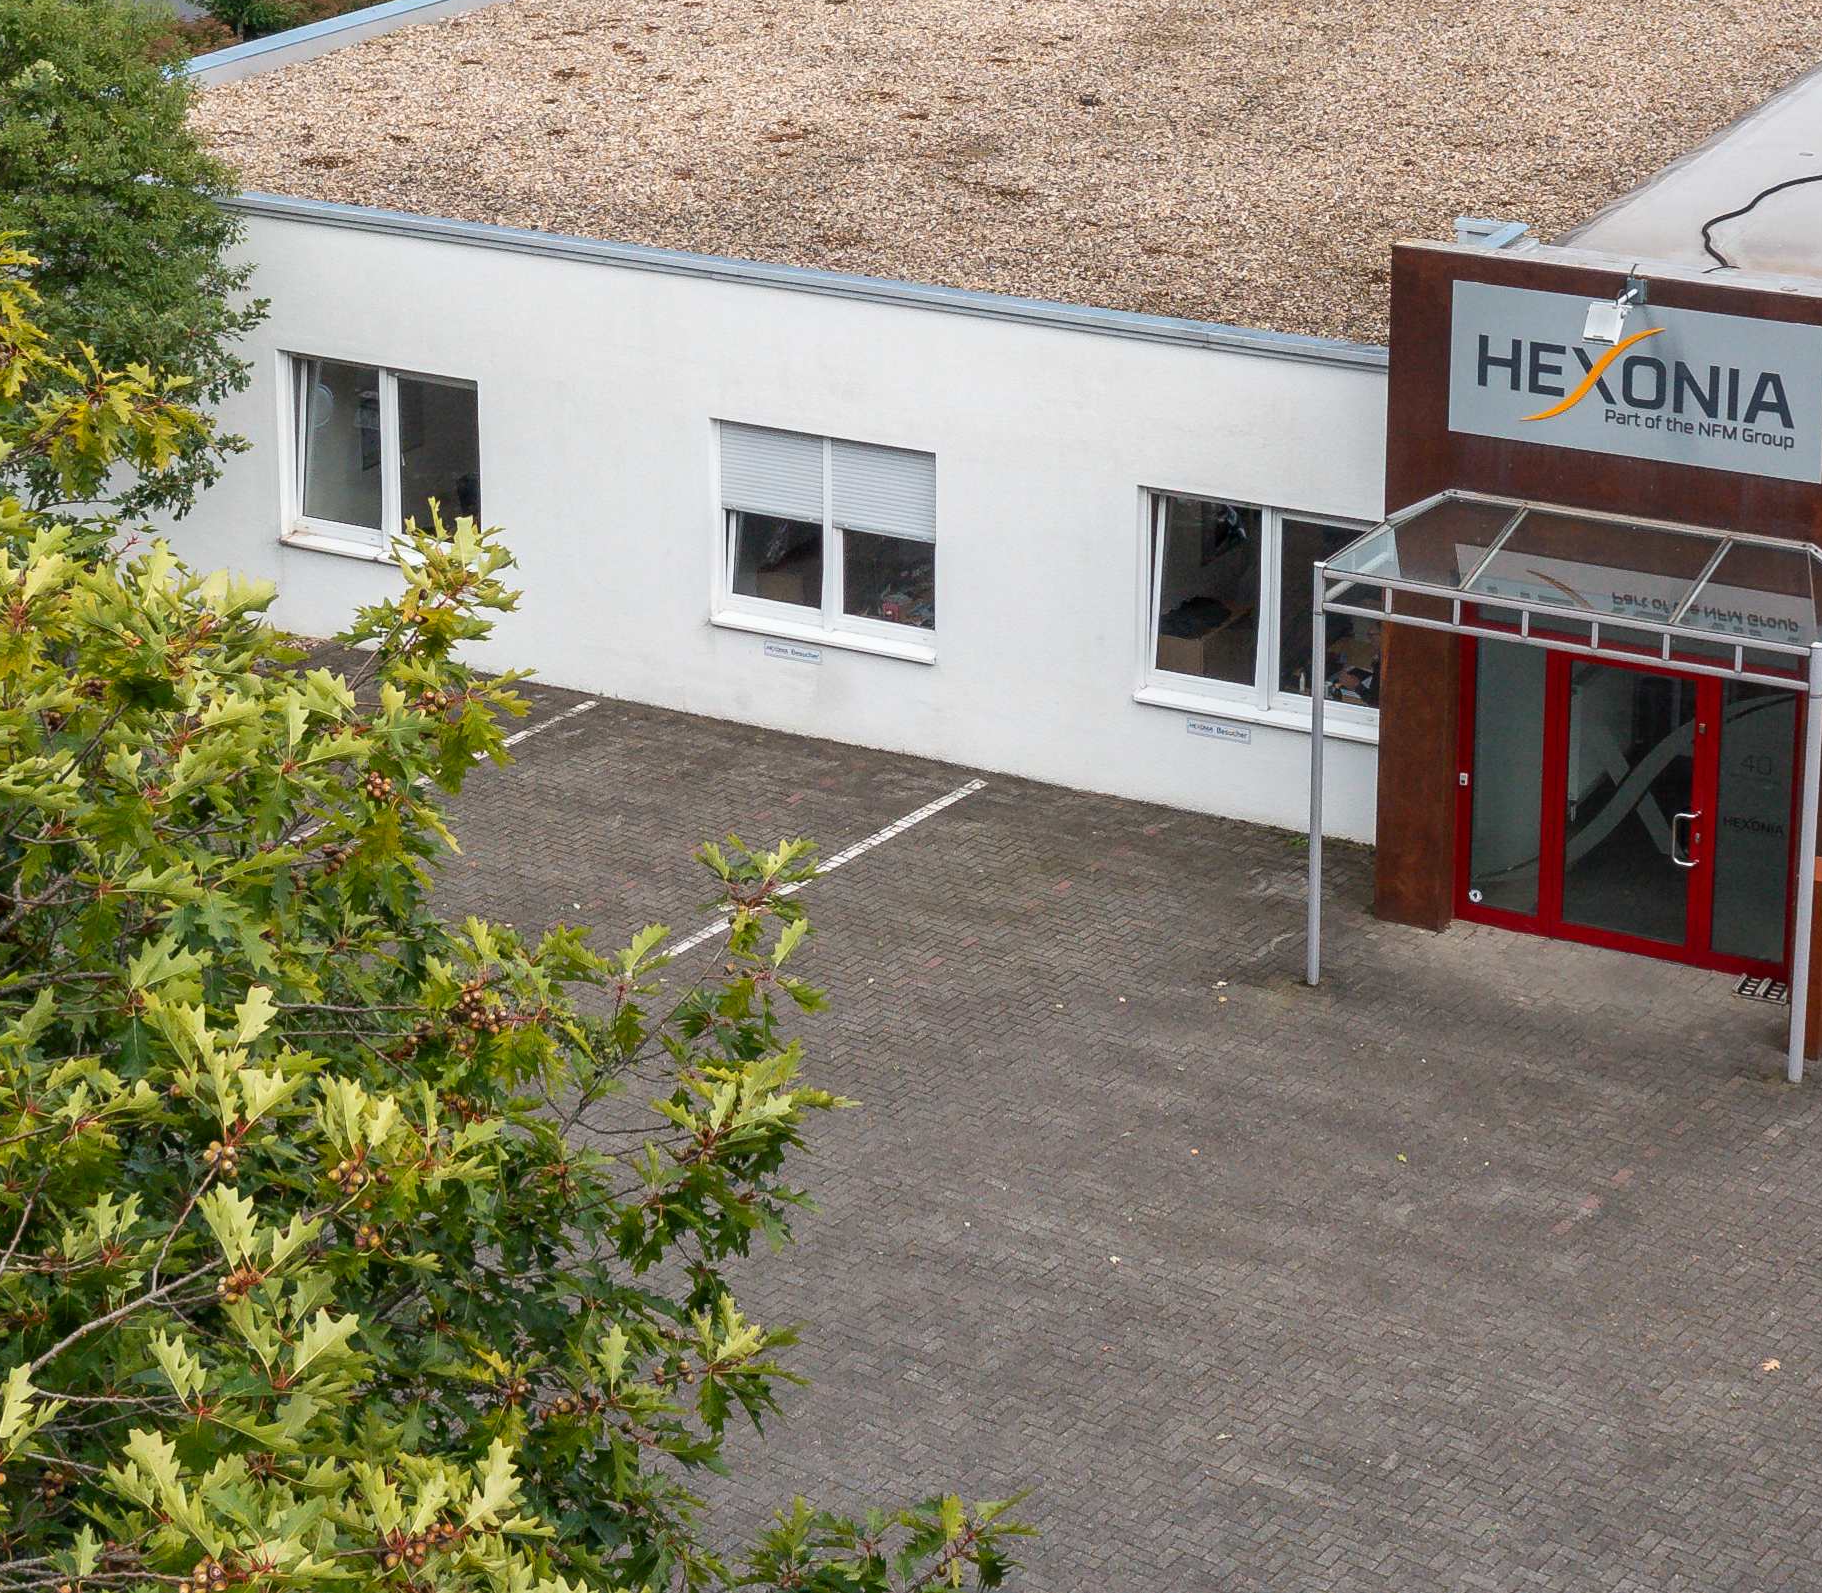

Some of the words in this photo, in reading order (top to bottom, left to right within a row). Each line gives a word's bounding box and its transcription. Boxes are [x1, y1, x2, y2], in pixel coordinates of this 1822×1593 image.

[1477, 327, 1795, 429] HEXONIA
[1604, 409, 1641, 427] Part
[1645, 414, 1663, 430] of
[1666, 417, 1694, 434] the
[1699, 421, 1738, 441] NFM
[1742, 428, 1795, 450] Group
[1723, 815, 1784, 836] HEXONIA
